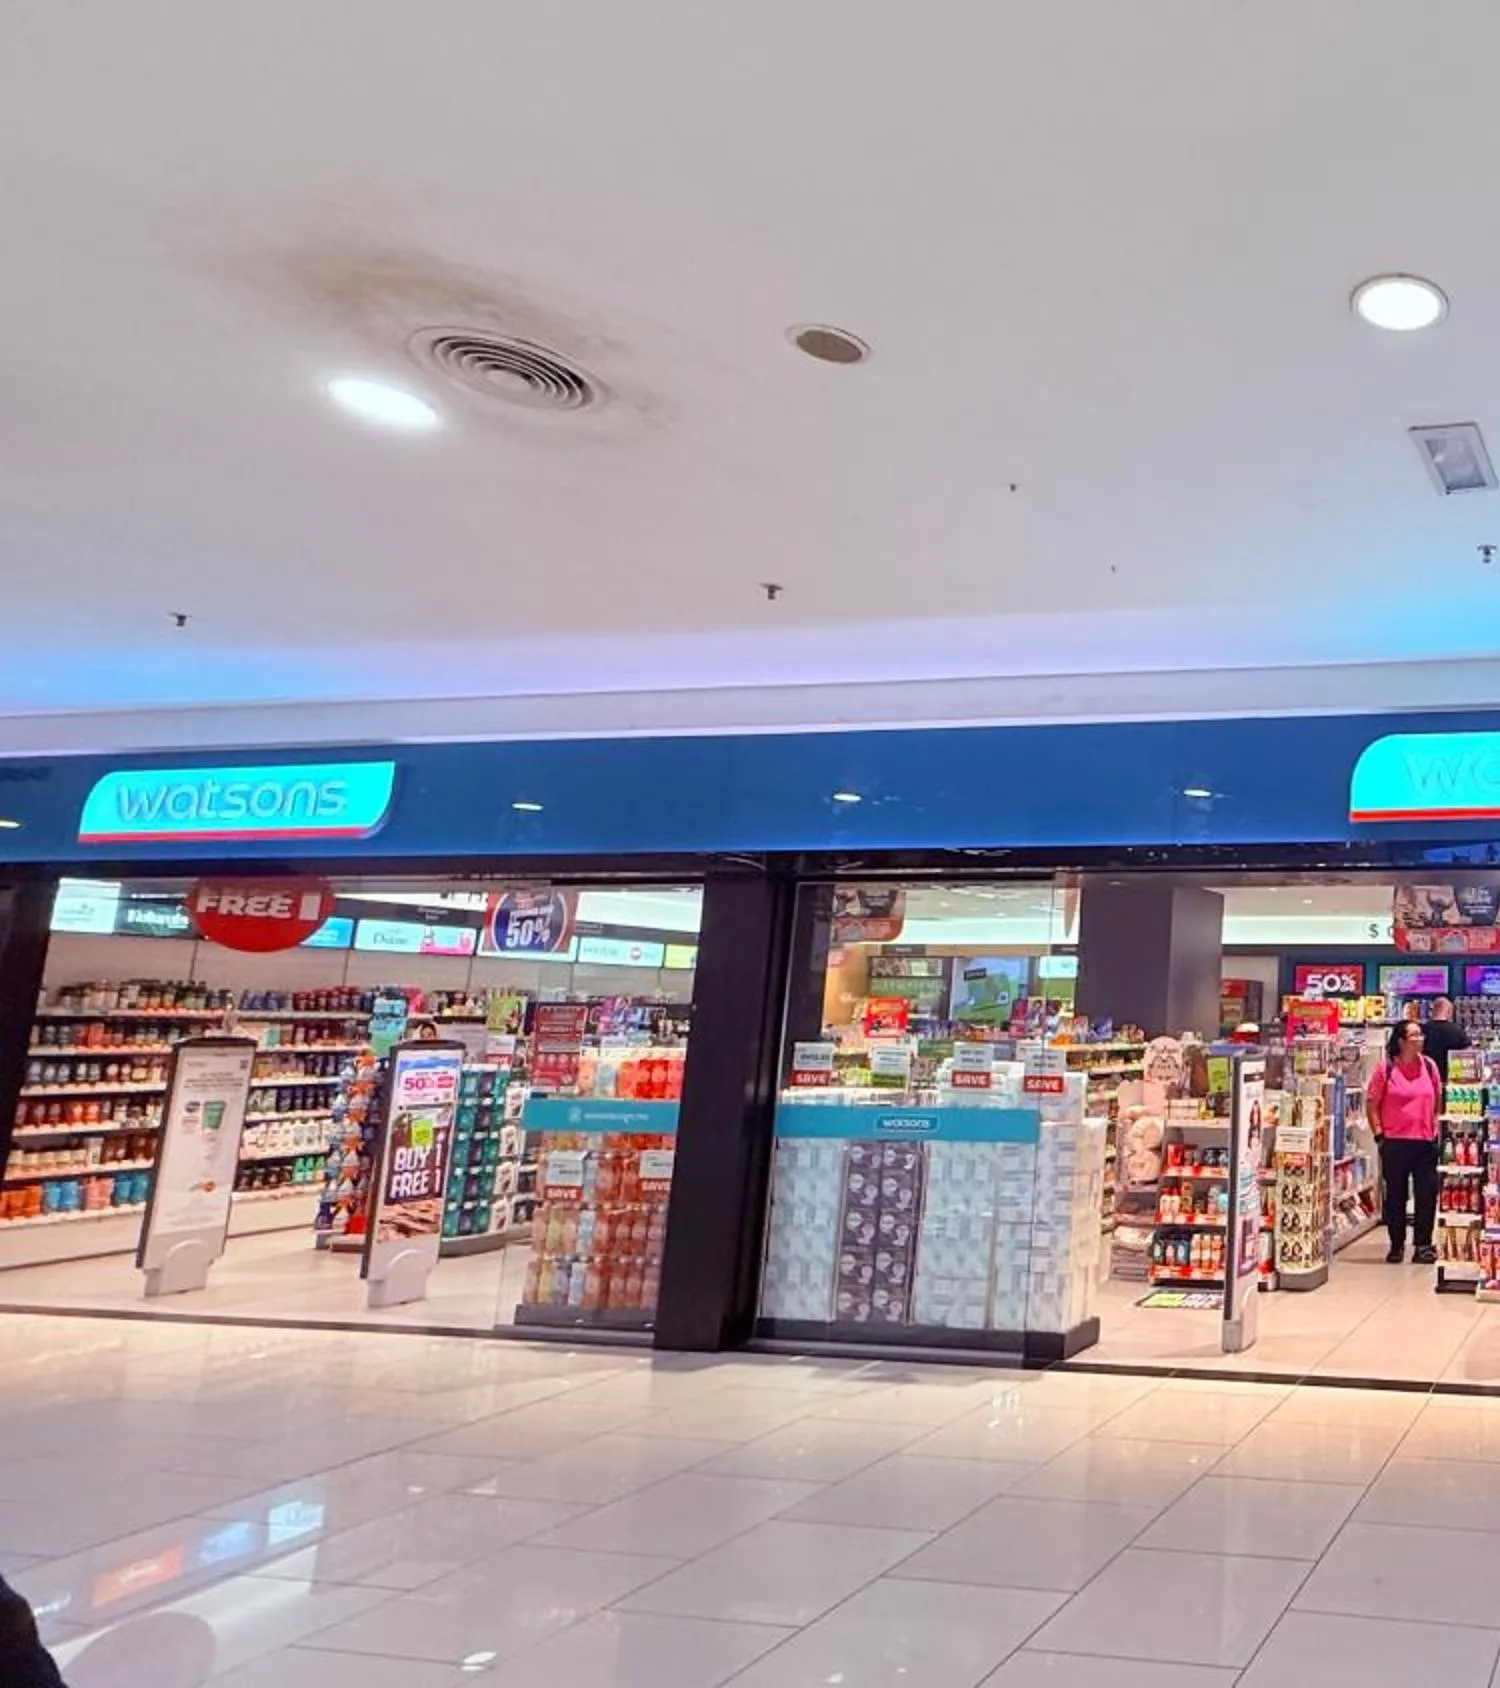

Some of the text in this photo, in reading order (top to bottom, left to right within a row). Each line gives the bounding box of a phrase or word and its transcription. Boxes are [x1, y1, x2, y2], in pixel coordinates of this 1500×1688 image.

[115, 779, 348, 821] watsons
[195, 888, 293, 919] FREE
[505, 915, 550, 947] 50%
[1306, 973, 1356, 992] 50%
[795, 1071, 827, 1084] SAVE
[955, 1072, 987, 1085] SAVE
[883, 1116, 930, 1129] watsons
[394, 1145, 431, 1172] BUY
[390, 1169, 429, 1199] FREE
[547, 1189, 577, 1199] SAVE
